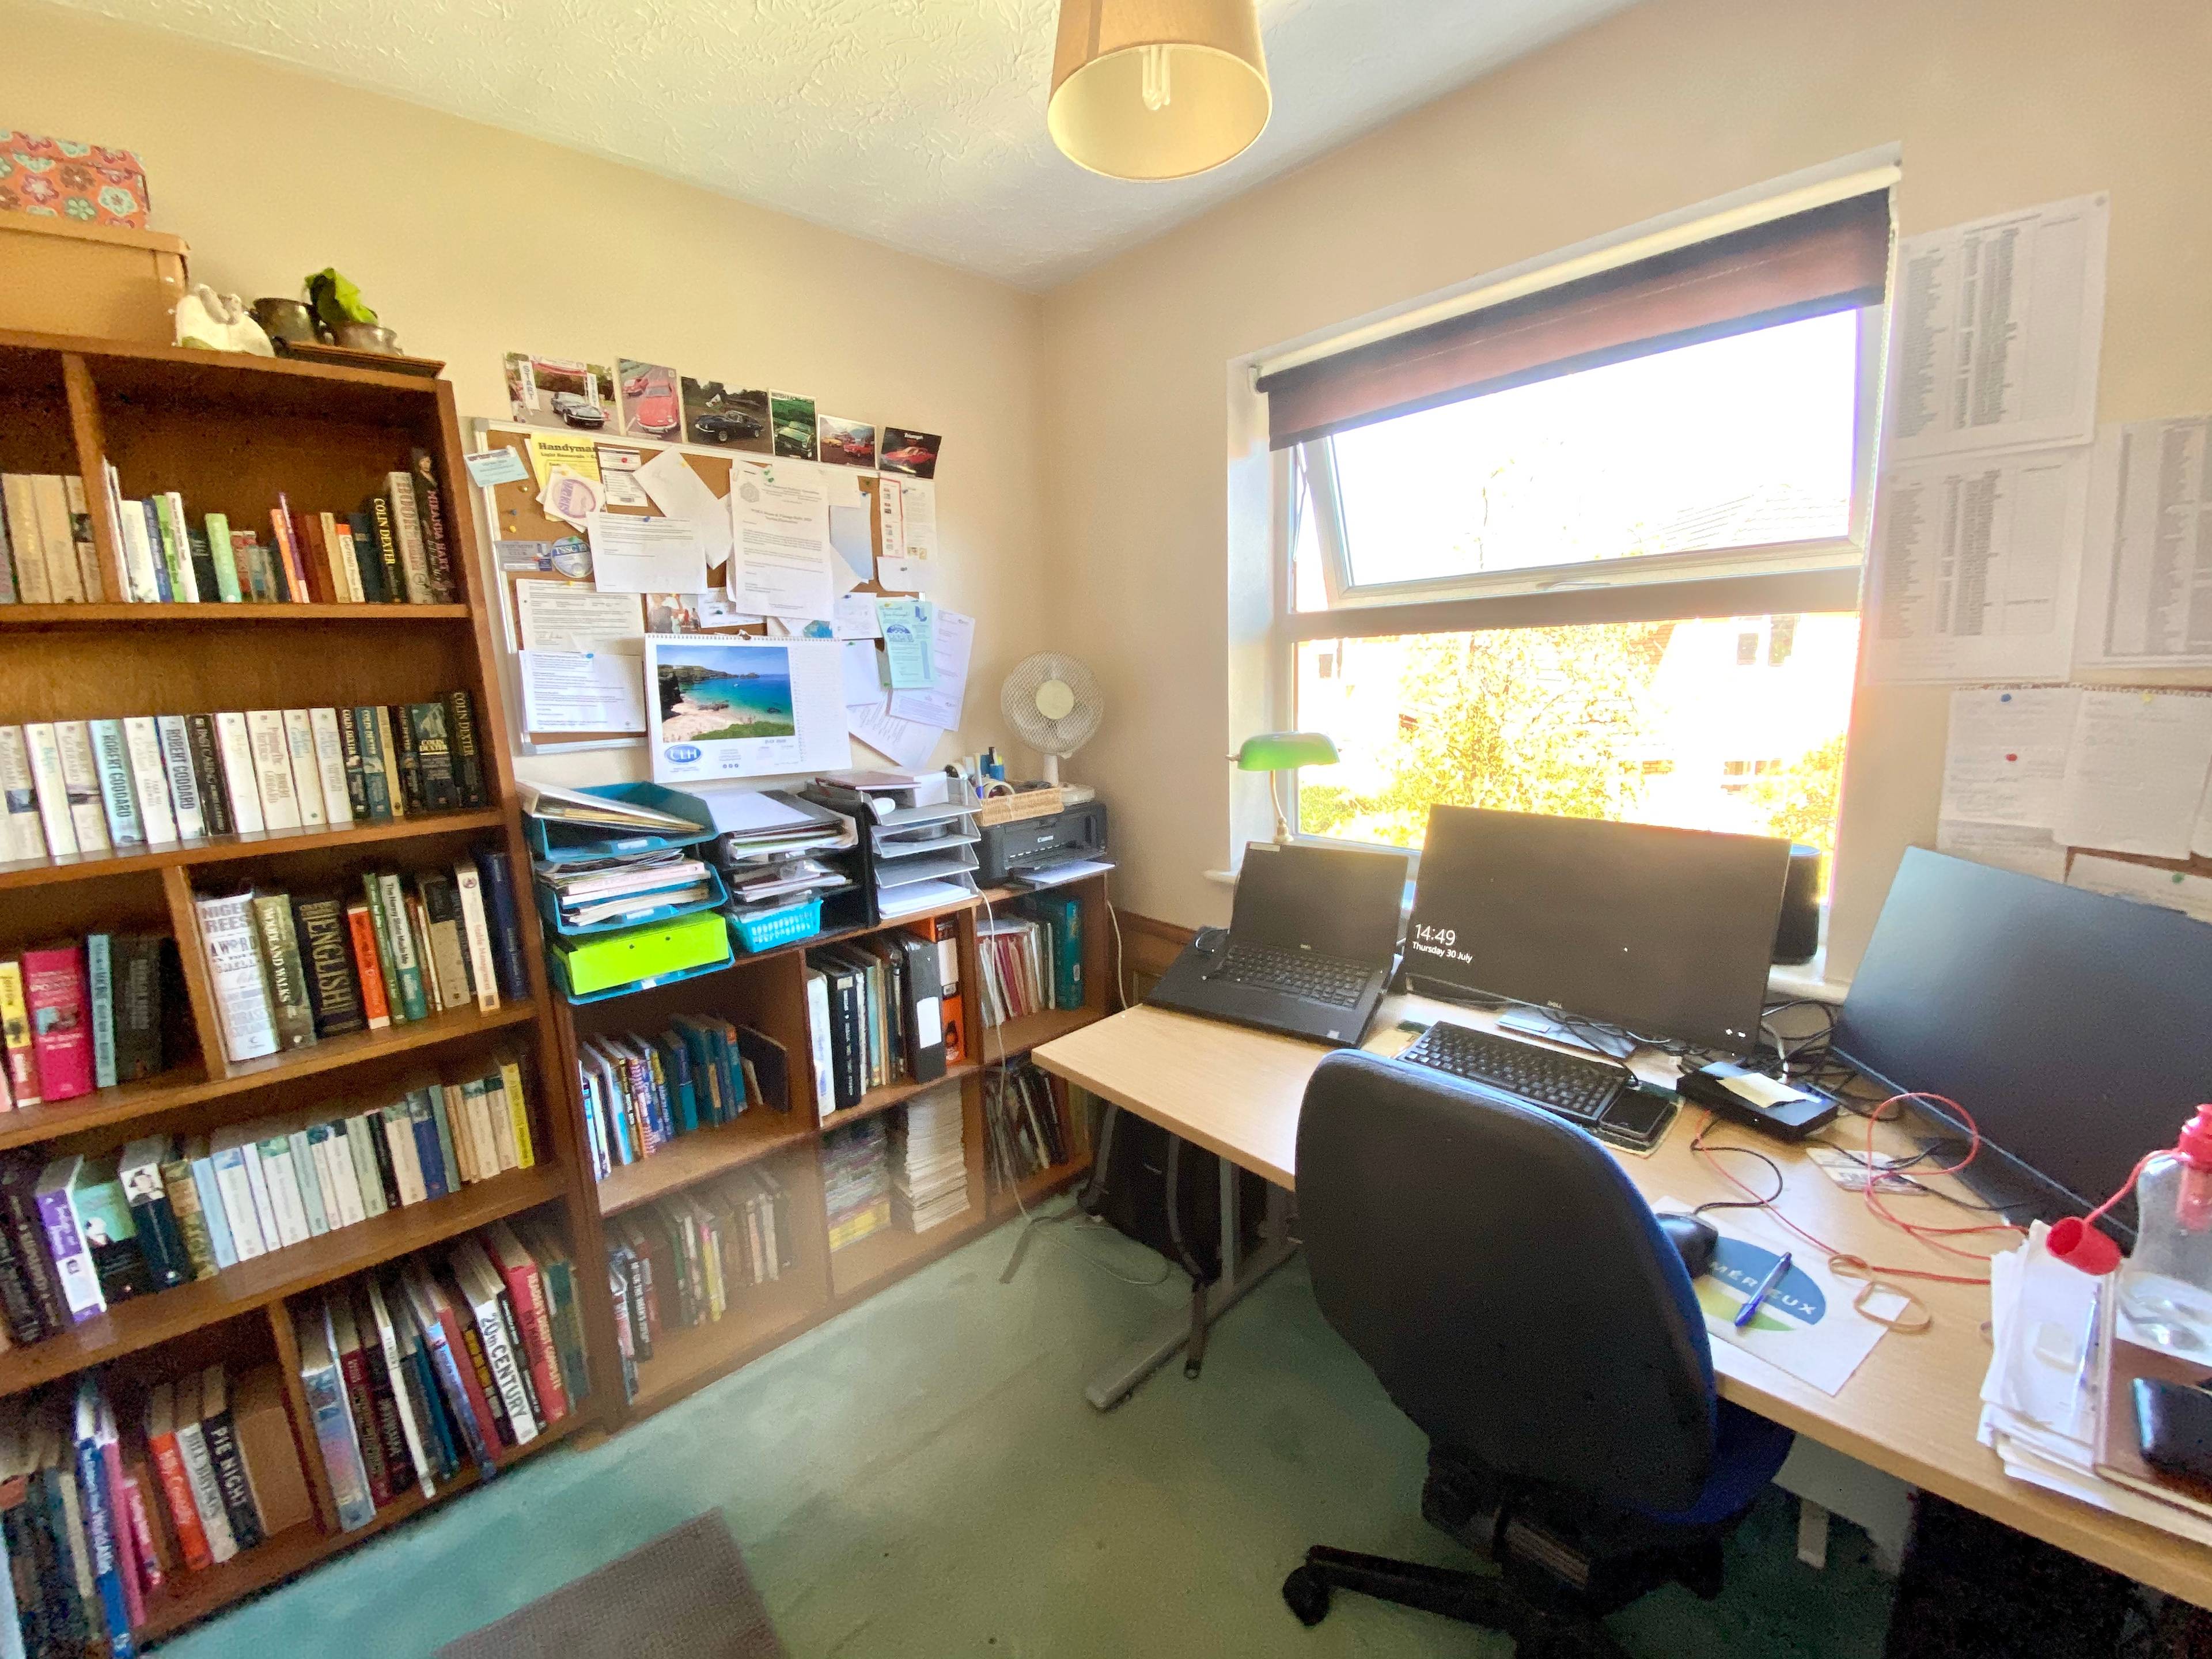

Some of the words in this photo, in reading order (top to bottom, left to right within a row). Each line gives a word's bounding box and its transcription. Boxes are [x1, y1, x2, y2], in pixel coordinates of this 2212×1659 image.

[522, 365, 534, 400] START
[374, 498, 389, 527] COLIN
[380, 529, 396, 565] DEXTER
[454, 692, 469, 719] COLIN
[103, 735, 122, 770] ROBERT
[166, 729, 187, 763] ROBERT
[459, 721, 475, 756] DEXTER
[669, 747, 698, 762] CLH
[109, 772, 132, 817] GODDARD
[173, 766, 196, 810] GODDARD
[385, 882, 394, 896] The
[388, 896, 400, 917] Nanny
[1415, 923, 1456, 946] 14:49
[261, 907, 285, 967] WOODLAND
[275, 967, 292, 1003] WALKS
[1412, 941, 1445, 957] Thursday
[1446, 949, 1457, 959] 30
[1457, 952, 1473, 964] July
[1547, 999, 1563, 1010] DELL
[491, 1344, 527, 1418] CENTURY
[219, 1456, 247, 1507] NIGHT
